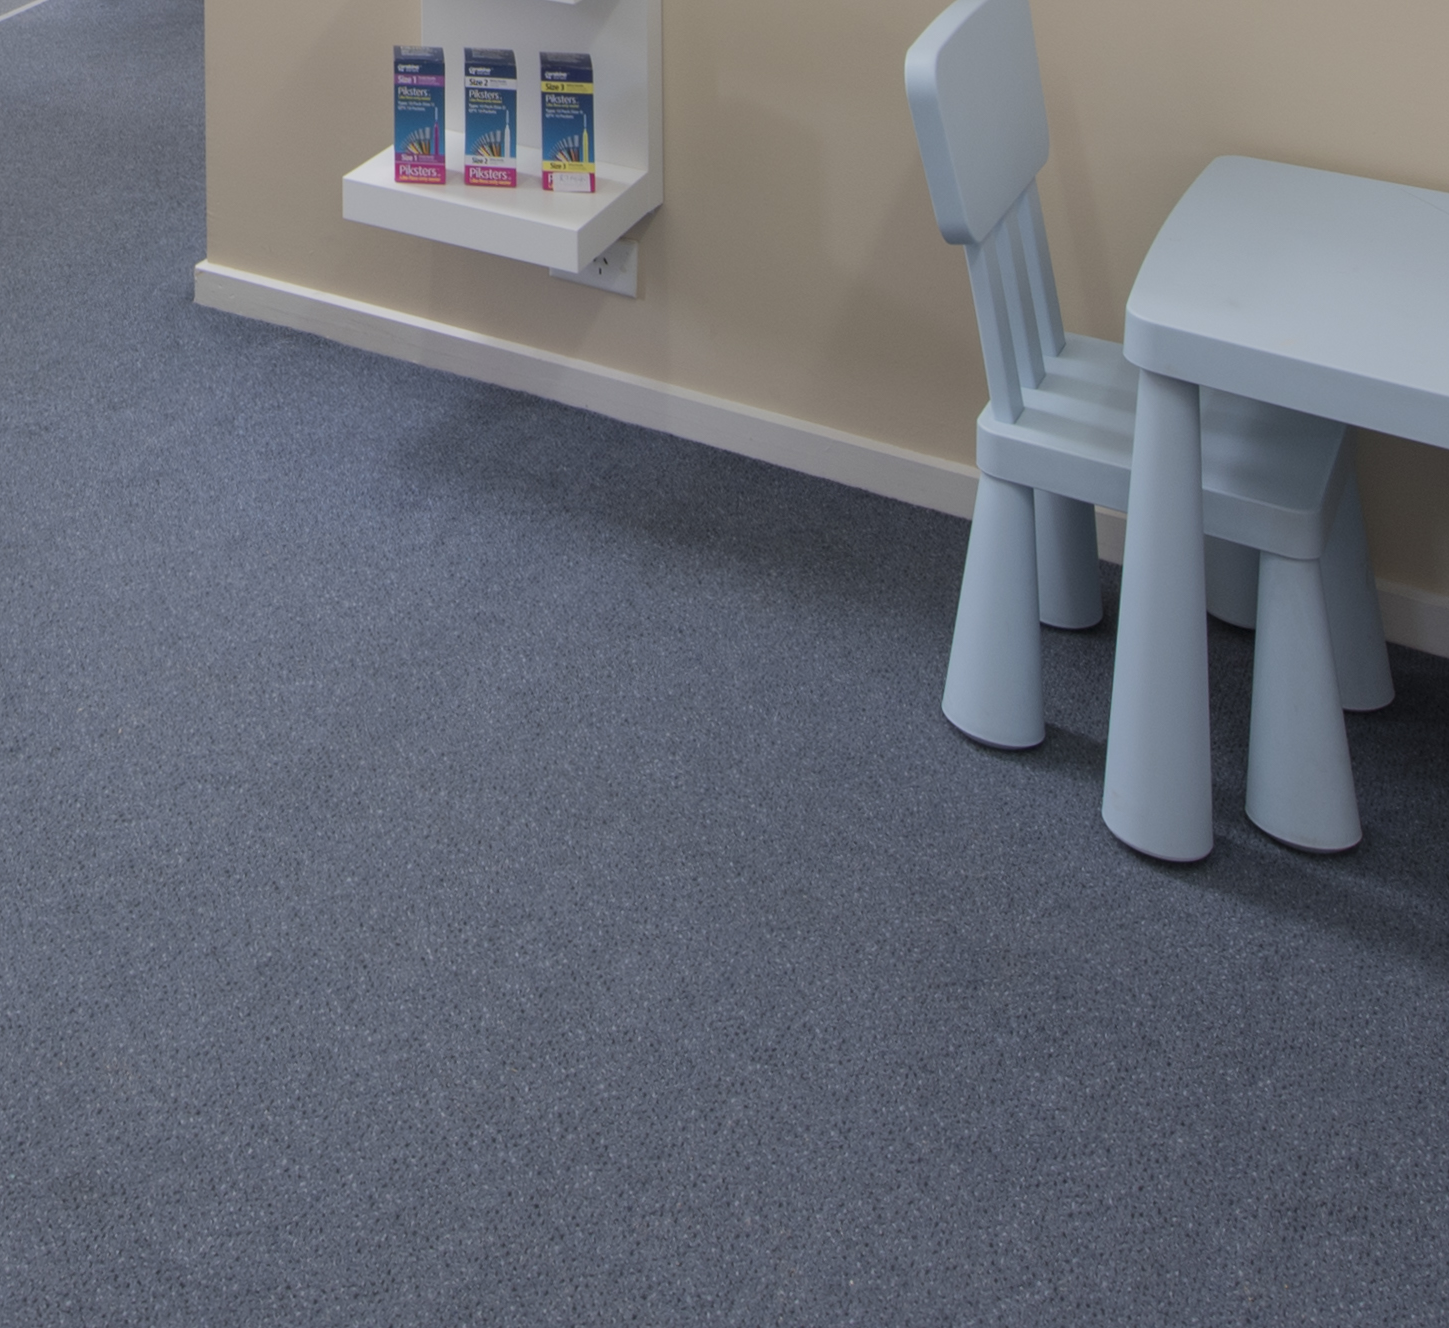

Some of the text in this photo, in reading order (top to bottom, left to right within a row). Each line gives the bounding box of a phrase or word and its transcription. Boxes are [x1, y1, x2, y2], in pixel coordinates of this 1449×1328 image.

[469, 78, 482, 86] Size
[397, 87, 428, 97] Piksters
[469, 89, 500, 100] Piksters
[545, 94, 577, 104] Piksters
[399, 164, 437, 176] Piksters
[469, 167, 508, 180] Piksters
